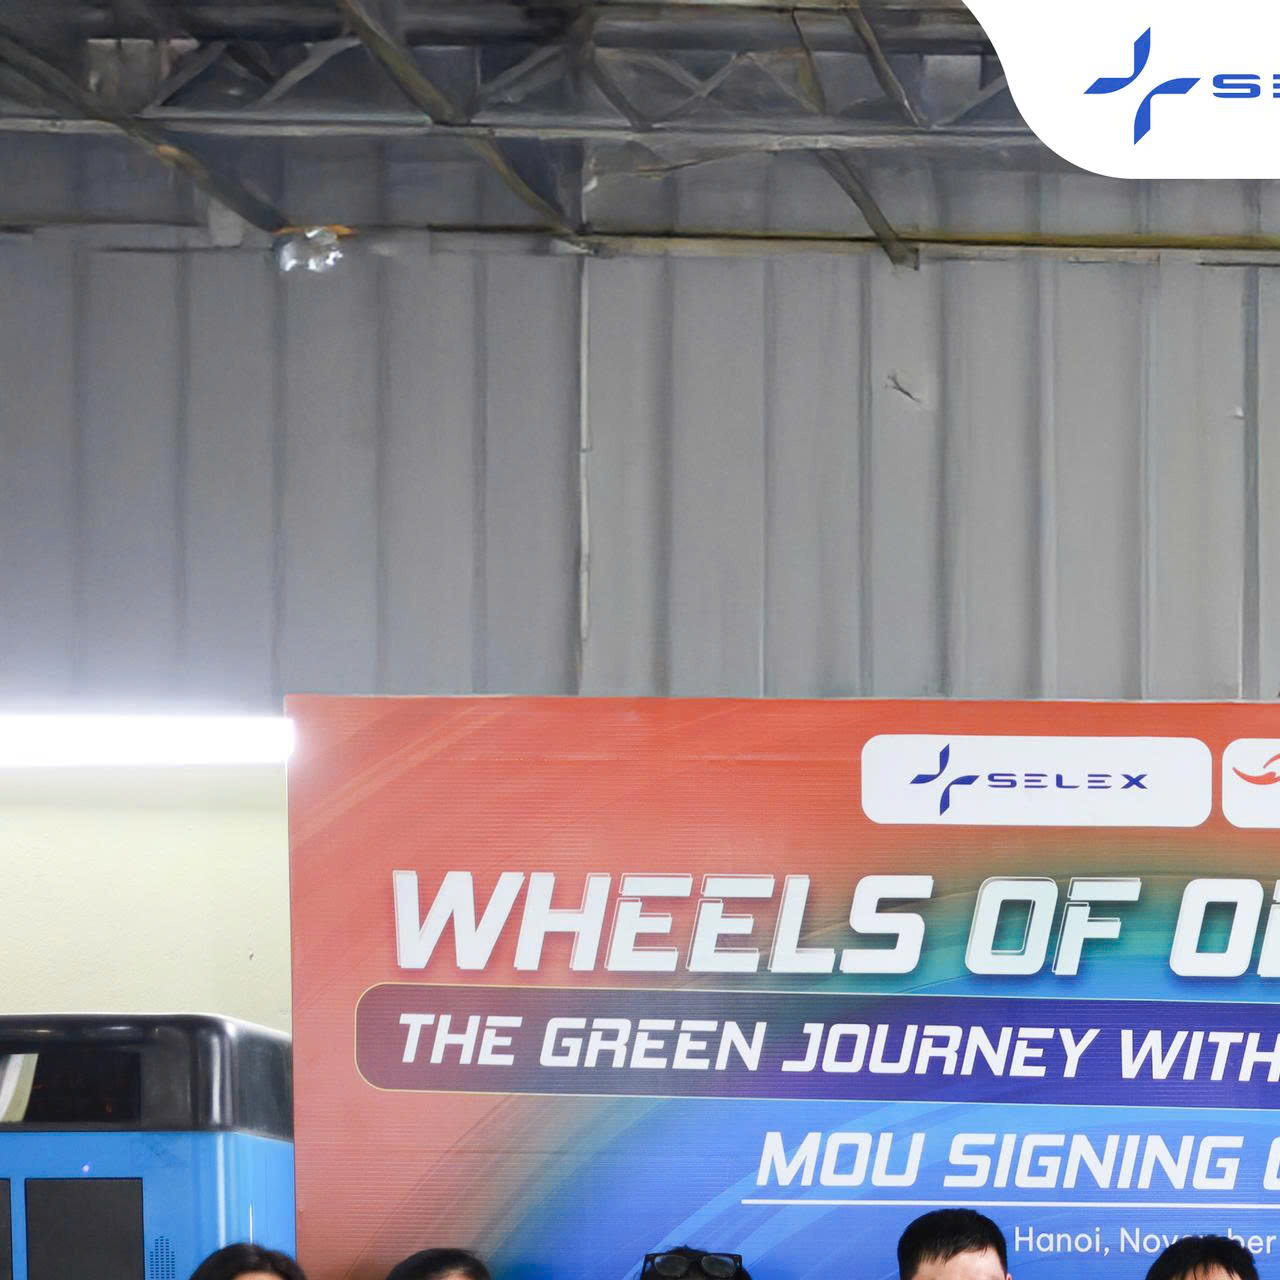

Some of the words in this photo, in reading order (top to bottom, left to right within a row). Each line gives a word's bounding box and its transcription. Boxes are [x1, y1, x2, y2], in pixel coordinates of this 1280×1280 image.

[987, 773, 1149, 790] SELEX
[393, 869, 934, 974] WHEELS
[965, 877, 1142, 977] OF
[398, 1013, 523, 1067] THE
[539, 1016, 768, 1072] GREEN
[781, 1022, 1101, 1079] JOURNEY
[757, 1131, 926, 1188] MOU
[944, 1133, 1244, 1191] SIGNING
[1013, 1226, 1110, 1257] Hanoi,
[1119, 1227, 1277, 1256] Novber
